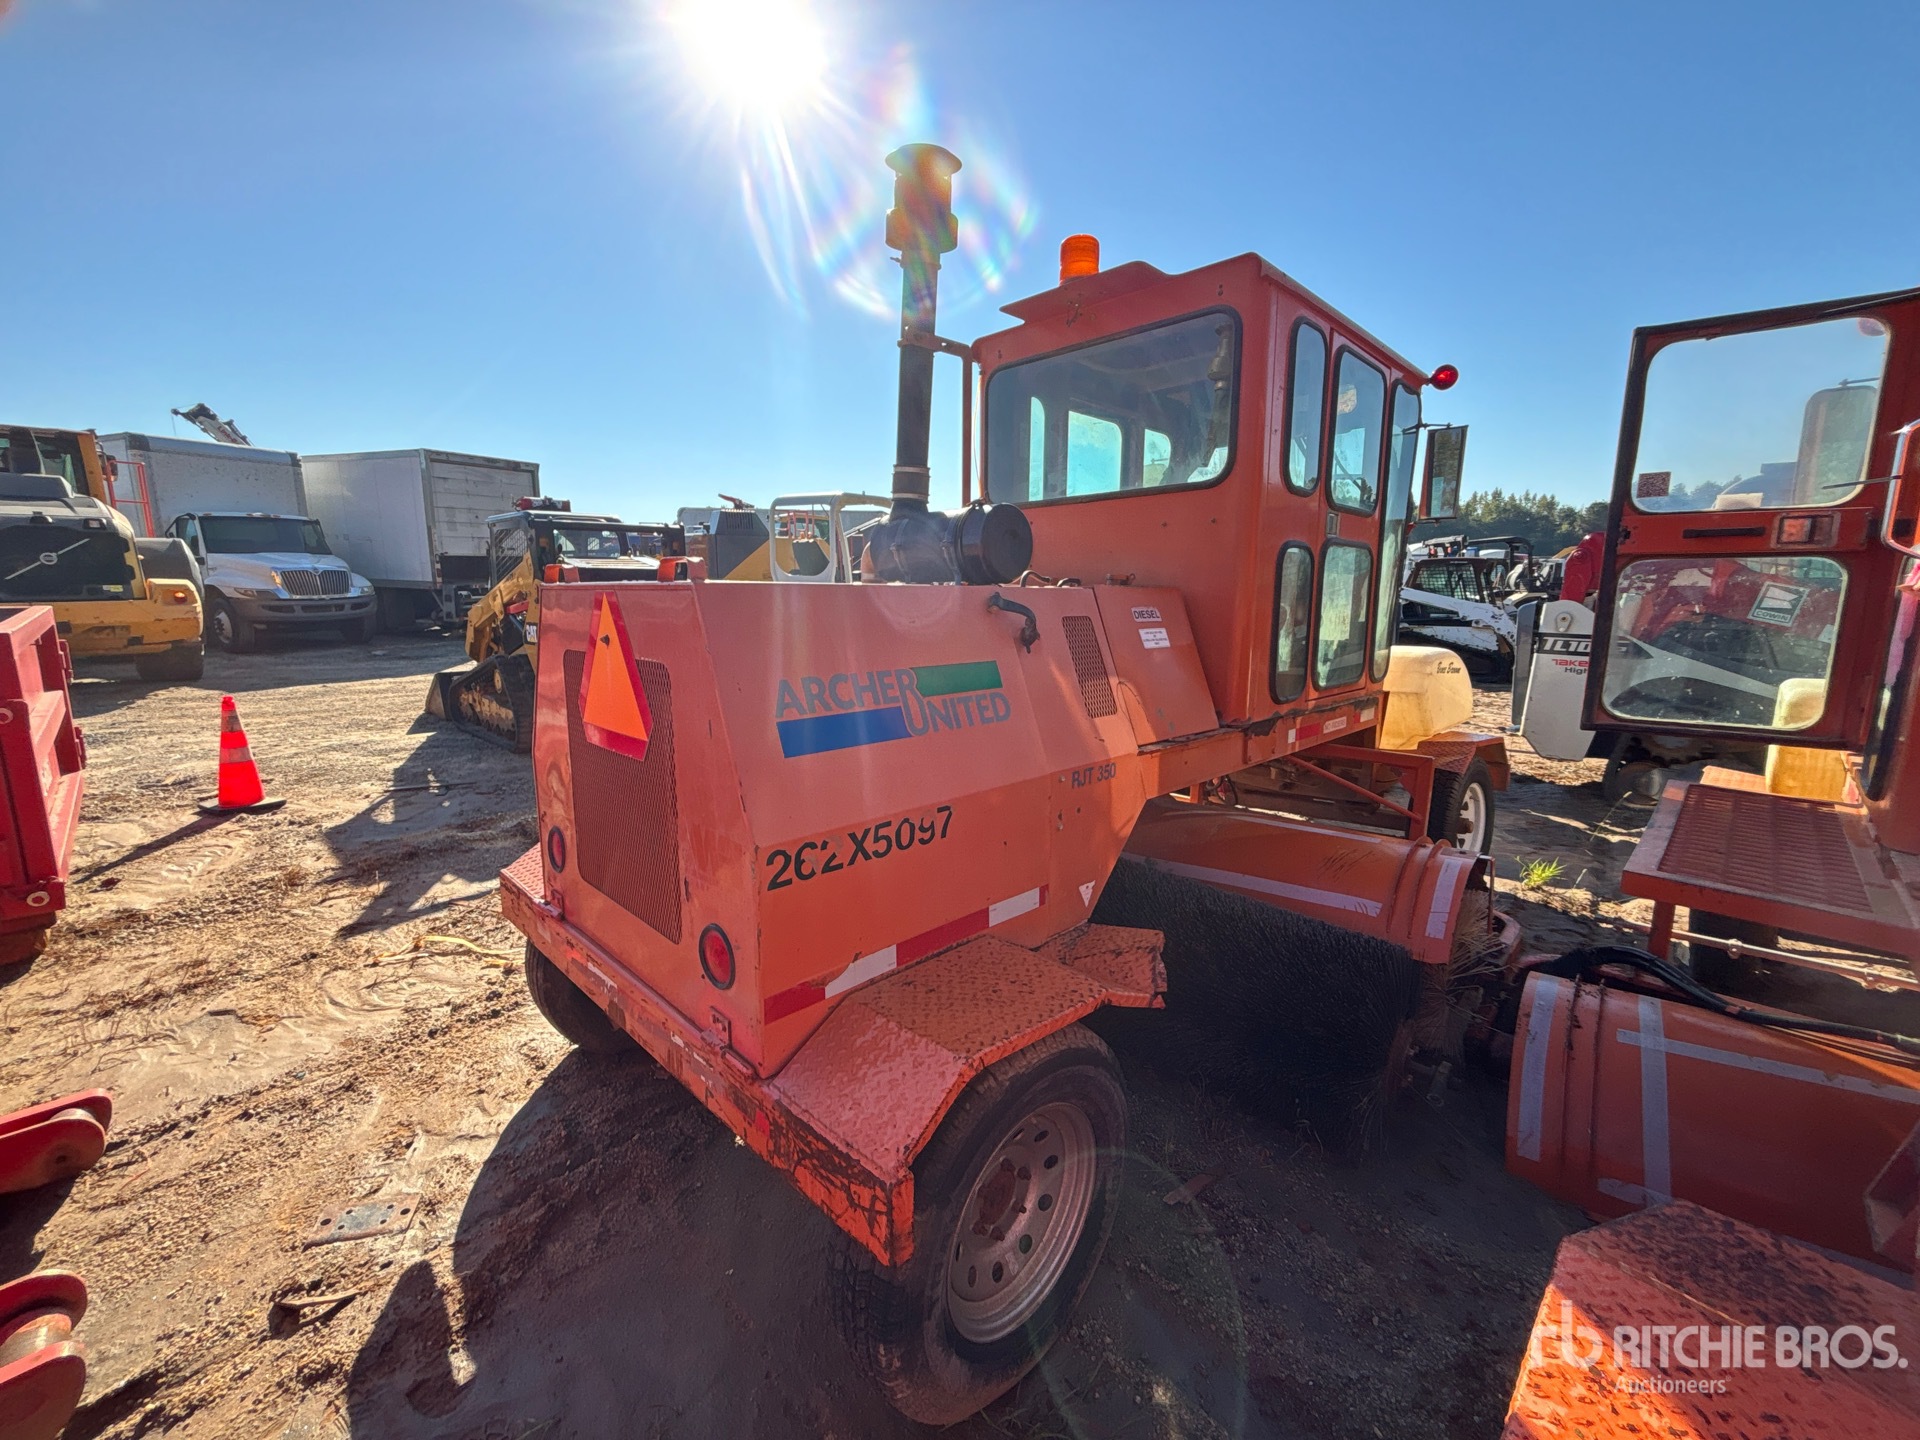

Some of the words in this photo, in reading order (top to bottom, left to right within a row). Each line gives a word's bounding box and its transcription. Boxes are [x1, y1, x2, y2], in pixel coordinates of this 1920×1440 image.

[1133, 609, 1160, 619] DIESEL
[1756, 610, 1790, 621] COWIN
[526, 624, 538, 642] CAT
[775, 668, 920, 718] ARCHER
[900, 692, 1011, 736] UNITED
[1071, 767, 1094, 790] RJT
[1097, 763, 1117, 782] 350
